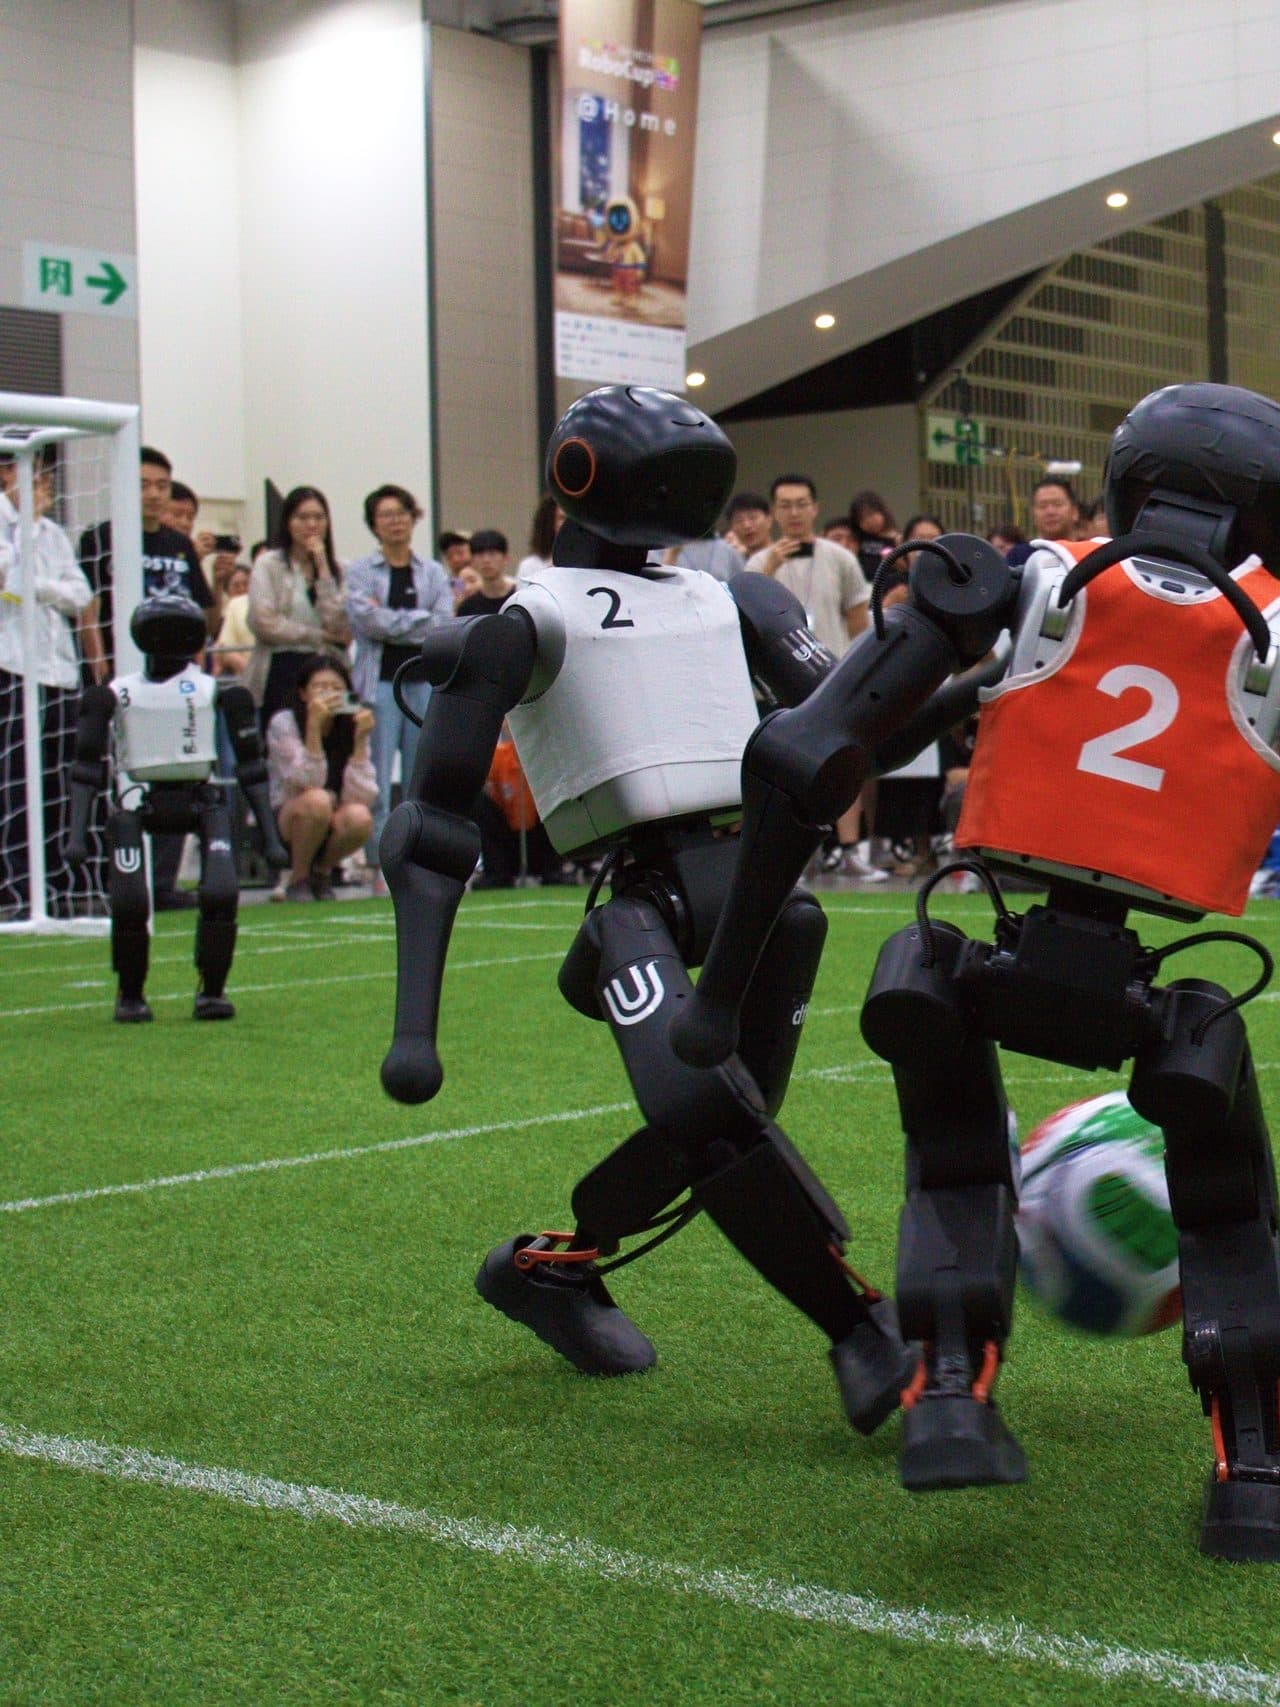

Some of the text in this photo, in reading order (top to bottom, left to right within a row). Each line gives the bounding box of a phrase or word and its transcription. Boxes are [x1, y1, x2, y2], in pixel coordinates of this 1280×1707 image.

[579, 95, 677, 136] @Home
[587, 587, 634, 629] 2
[119, 688, 131, 708] 3
[1076, 664, 1180, 792] 2
